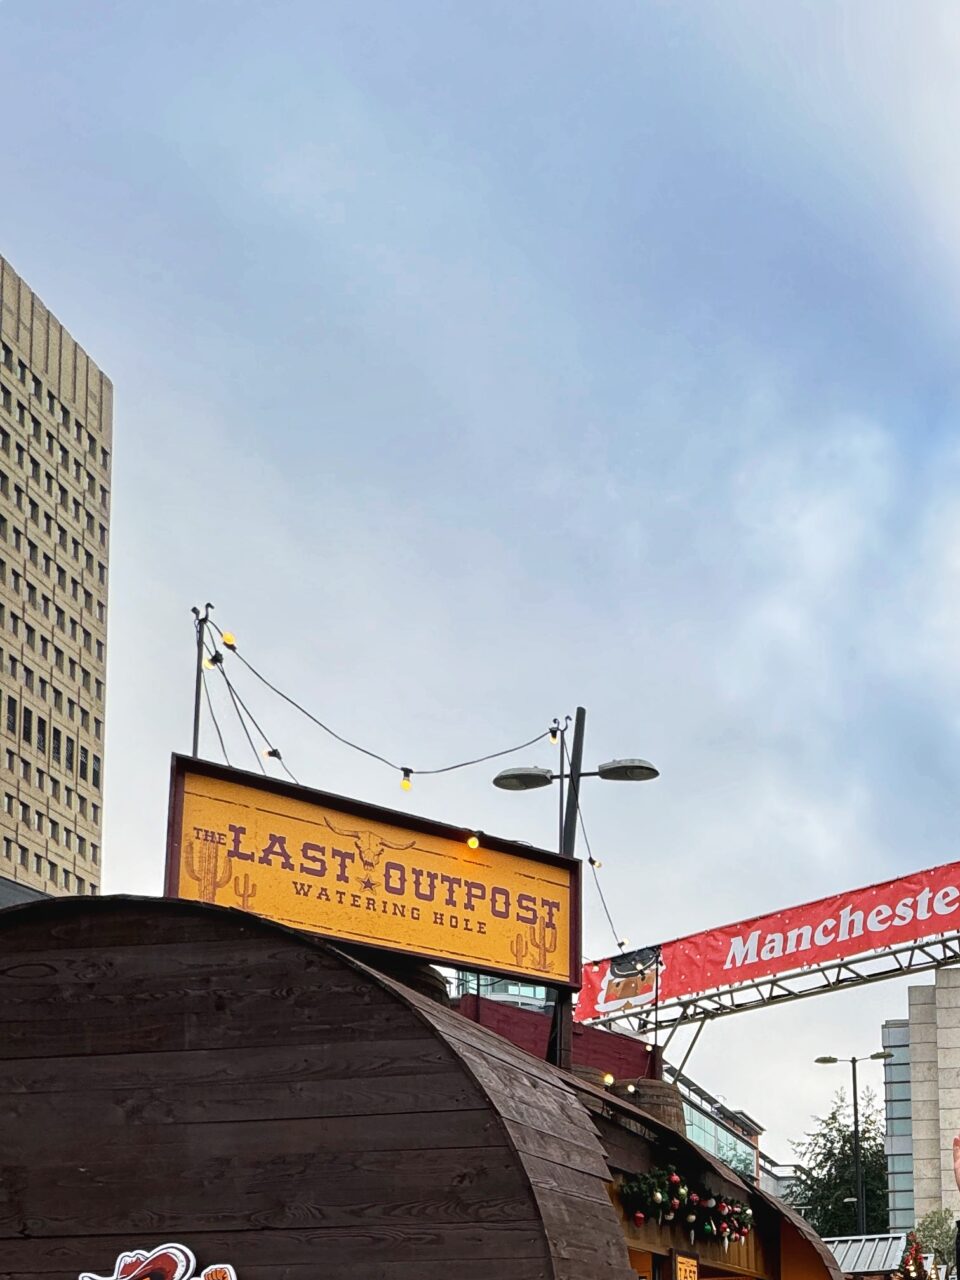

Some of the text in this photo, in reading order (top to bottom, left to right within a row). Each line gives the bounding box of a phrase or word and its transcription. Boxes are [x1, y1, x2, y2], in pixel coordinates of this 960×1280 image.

[193, 824, 561, 929] THE LAST OUTPOST
[292, 880, 488, 935] WATERING HOLE
